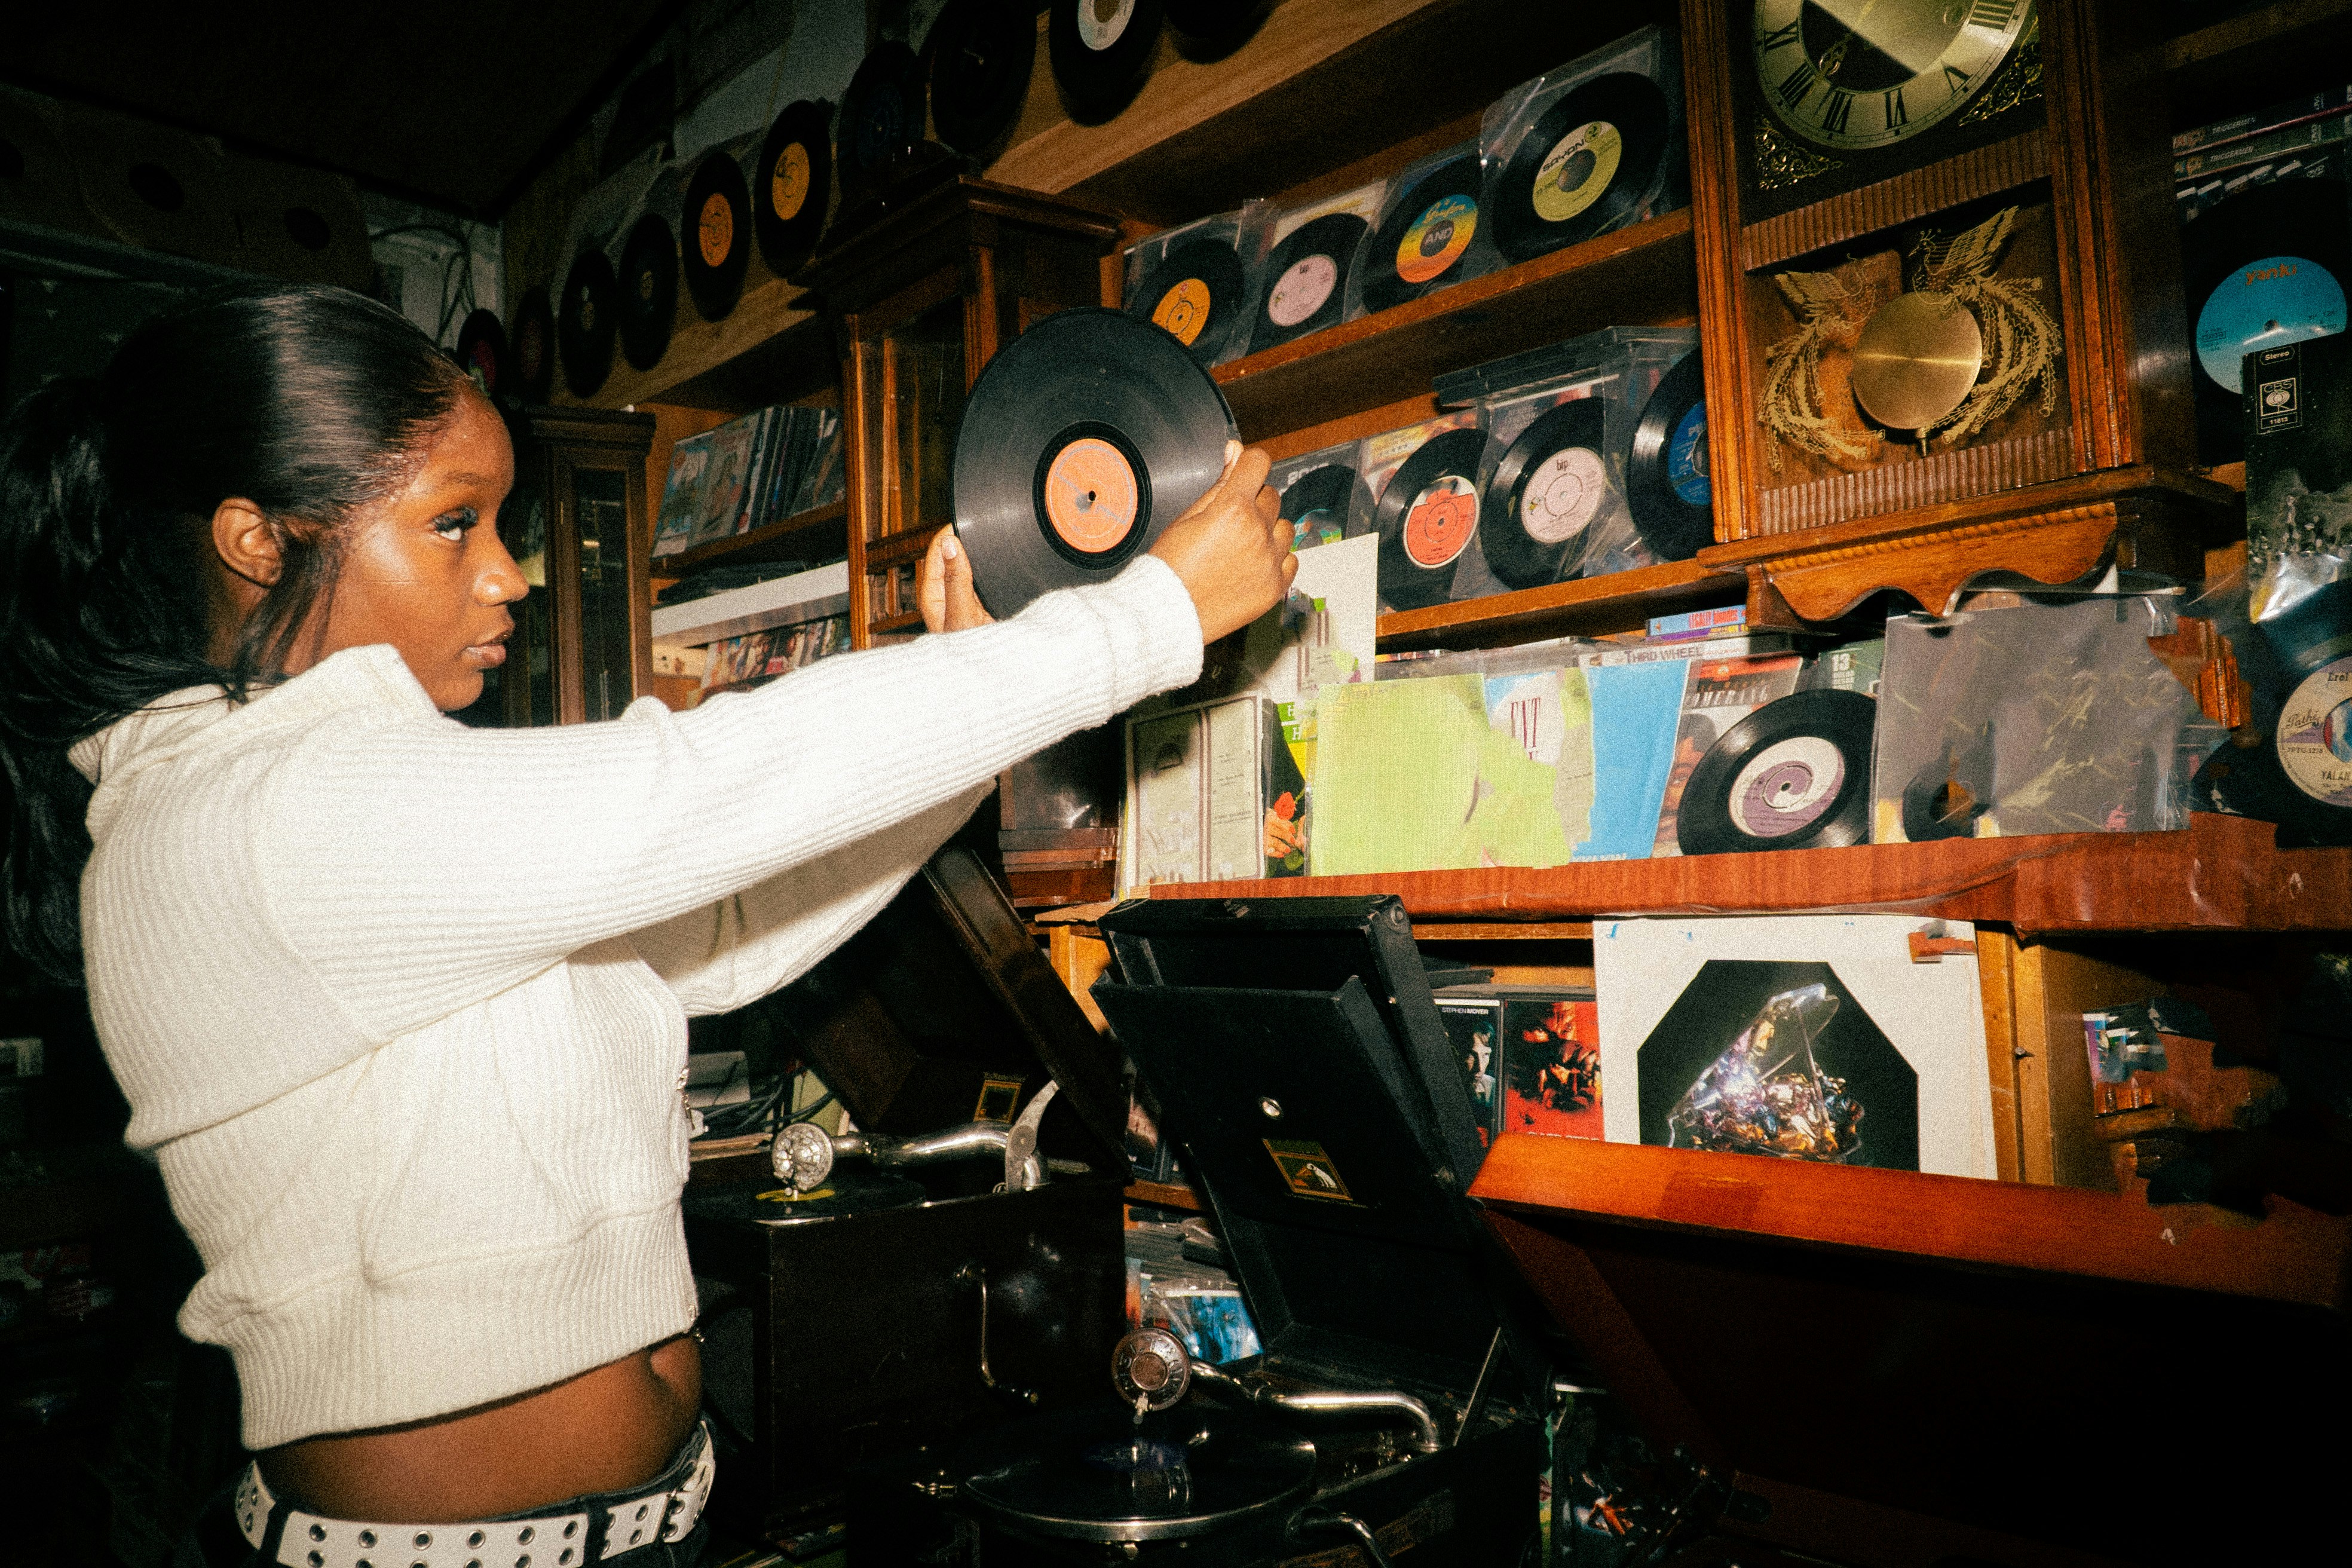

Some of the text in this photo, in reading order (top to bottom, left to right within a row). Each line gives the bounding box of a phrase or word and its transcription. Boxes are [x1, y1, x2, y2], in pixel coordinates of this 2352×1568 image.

[1424, 227, 1454, 246] AND
[2264, 351, 2290, 360] Stereo
[2264, 380, 2293, 393] CBS
[1624, 650, 1658, 664] THIRD
[1660, 647, 1703, 660] WHEEL
[1831, 653, 1851, 672] 13
[2328, 672, 2349, 682] Erol
